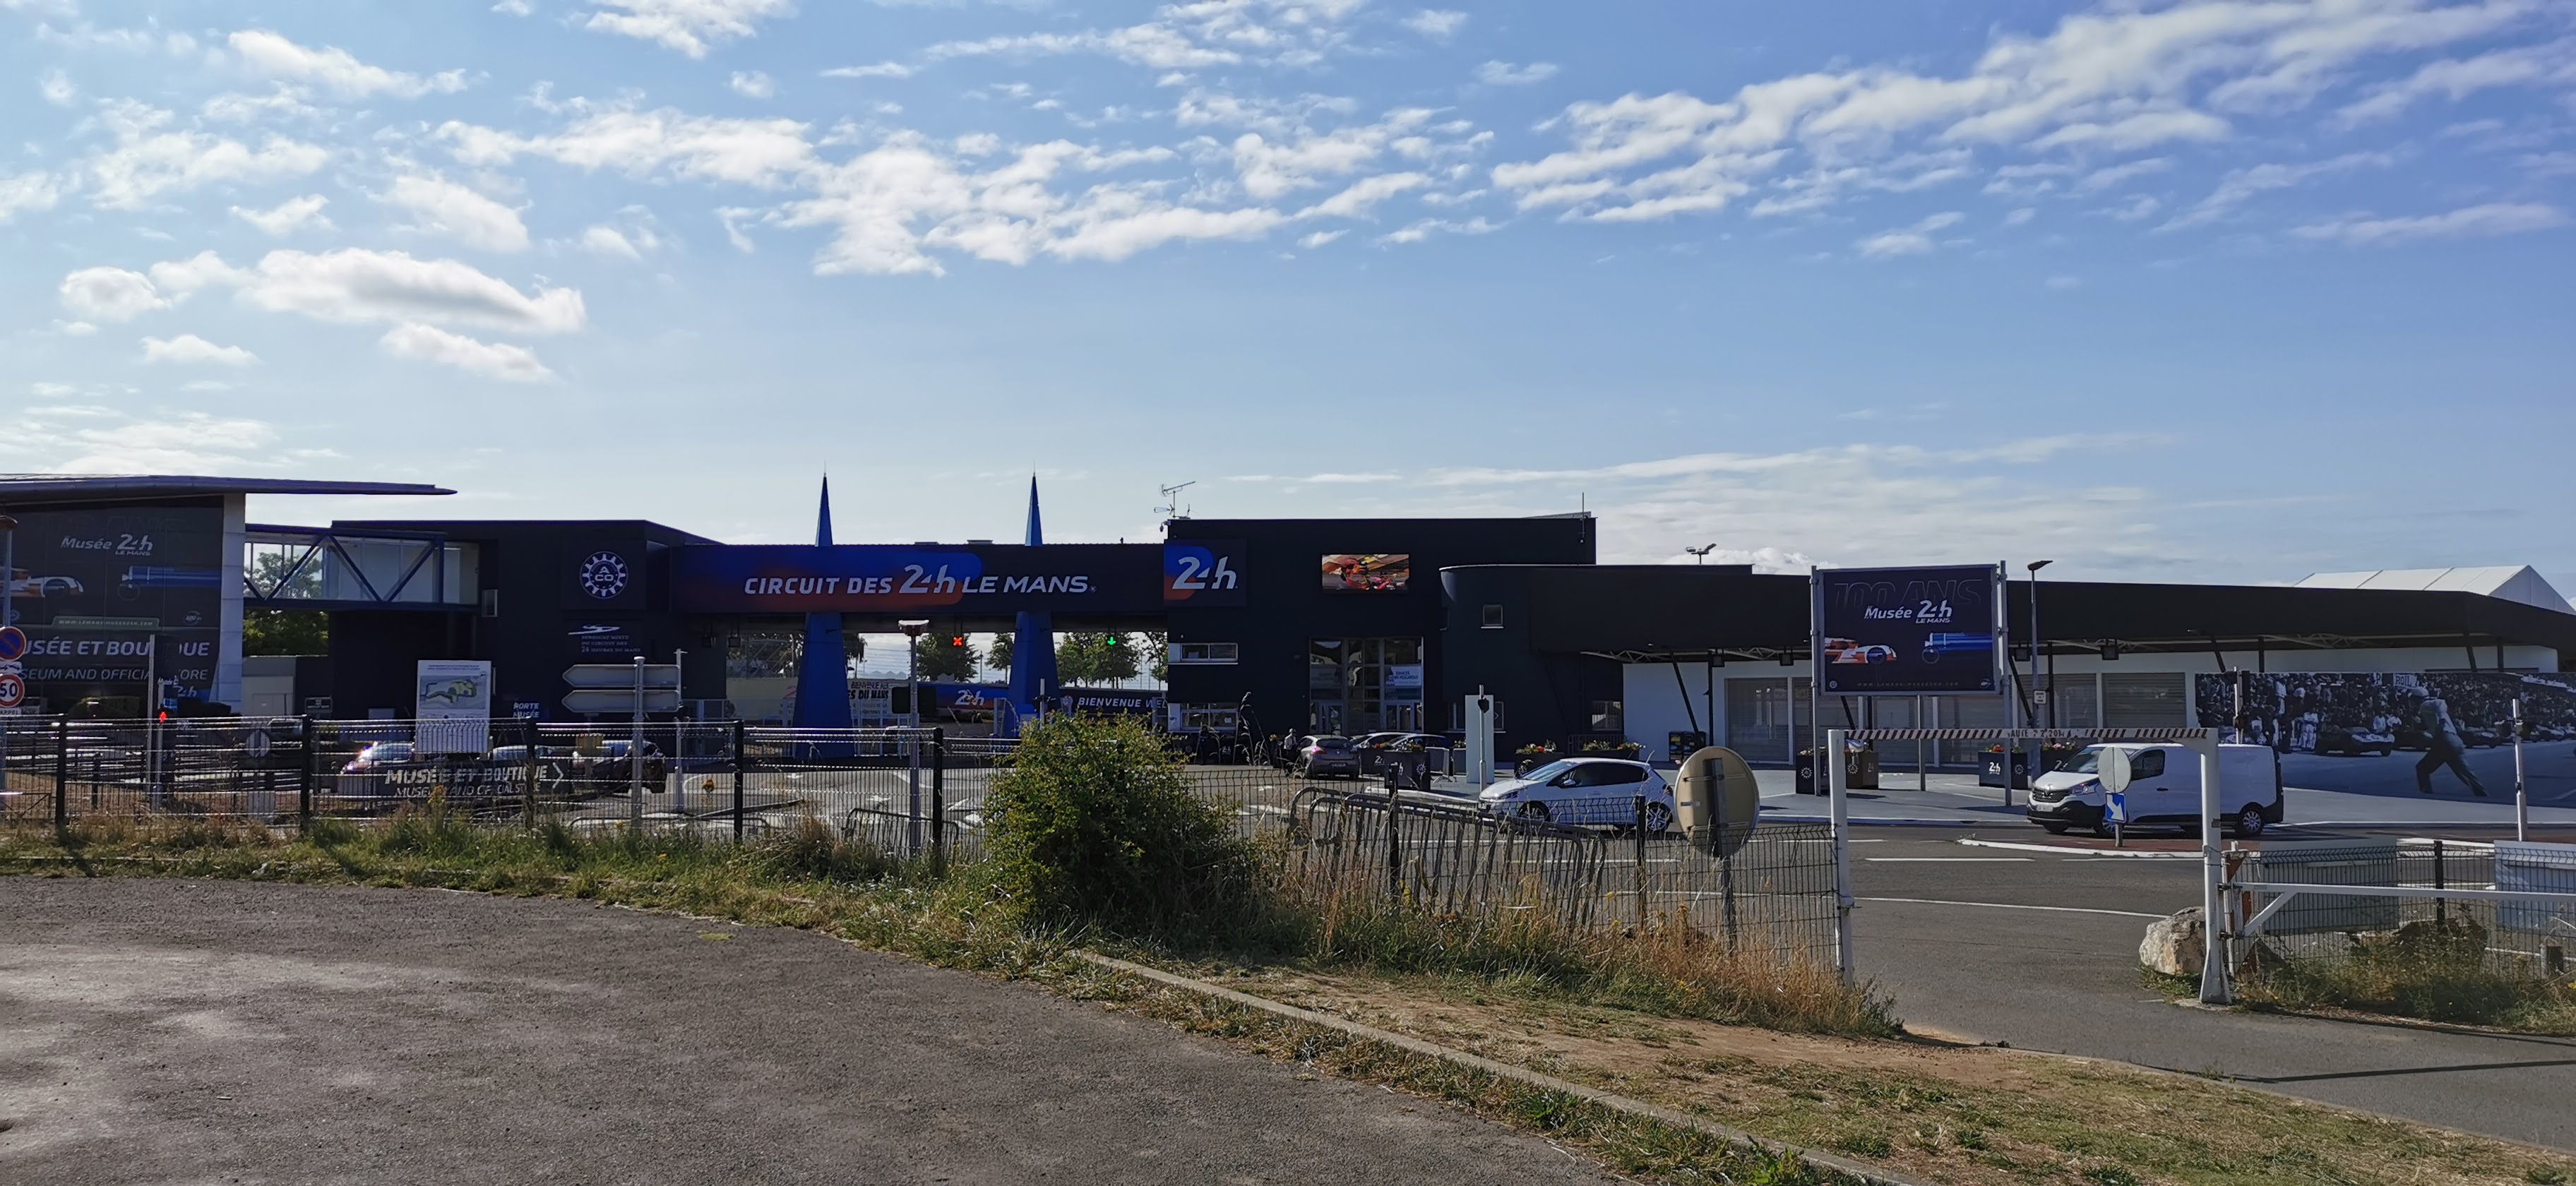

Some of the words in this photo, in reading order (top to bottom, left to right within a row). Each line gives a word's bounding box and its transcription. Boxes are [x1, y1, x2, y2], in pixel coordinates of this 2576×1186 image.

[61, 537, 112, 549] Musée
[117, 533, 153, 551] 24h
[744, 577, 840, 594] CIRCUIT
[847, 577, 893, 594] DES
[899, 564, 955, 594] 24h
[962, 576, 998, 594] LE
[1003, 575, 1089, 594] MANS
[1172, 556, 1236, 589] 24h
[1834, 582, 1896, 609] 100
[1902, 579, 1983, 606] ANS
[1864, 605, 1912, 619] Musée
[1916, 599, 1952, 618] 24h
[24, 635, 73, 655] USÉE
[77, 641, 105, 656] ET
[106, 641, 210, 657] BOUUE
[21, 668, 62, 680] SEUM
[64, 668, 97, 680] AND
[178, 669, 209, 681] ORE
[858, 690, 870, 700] DU
[1078, 697, 1142, 708] BIENVENUE
[1145, 699, 1167, 709] WEL
[385, 765, 453, 784] MUSÉE
